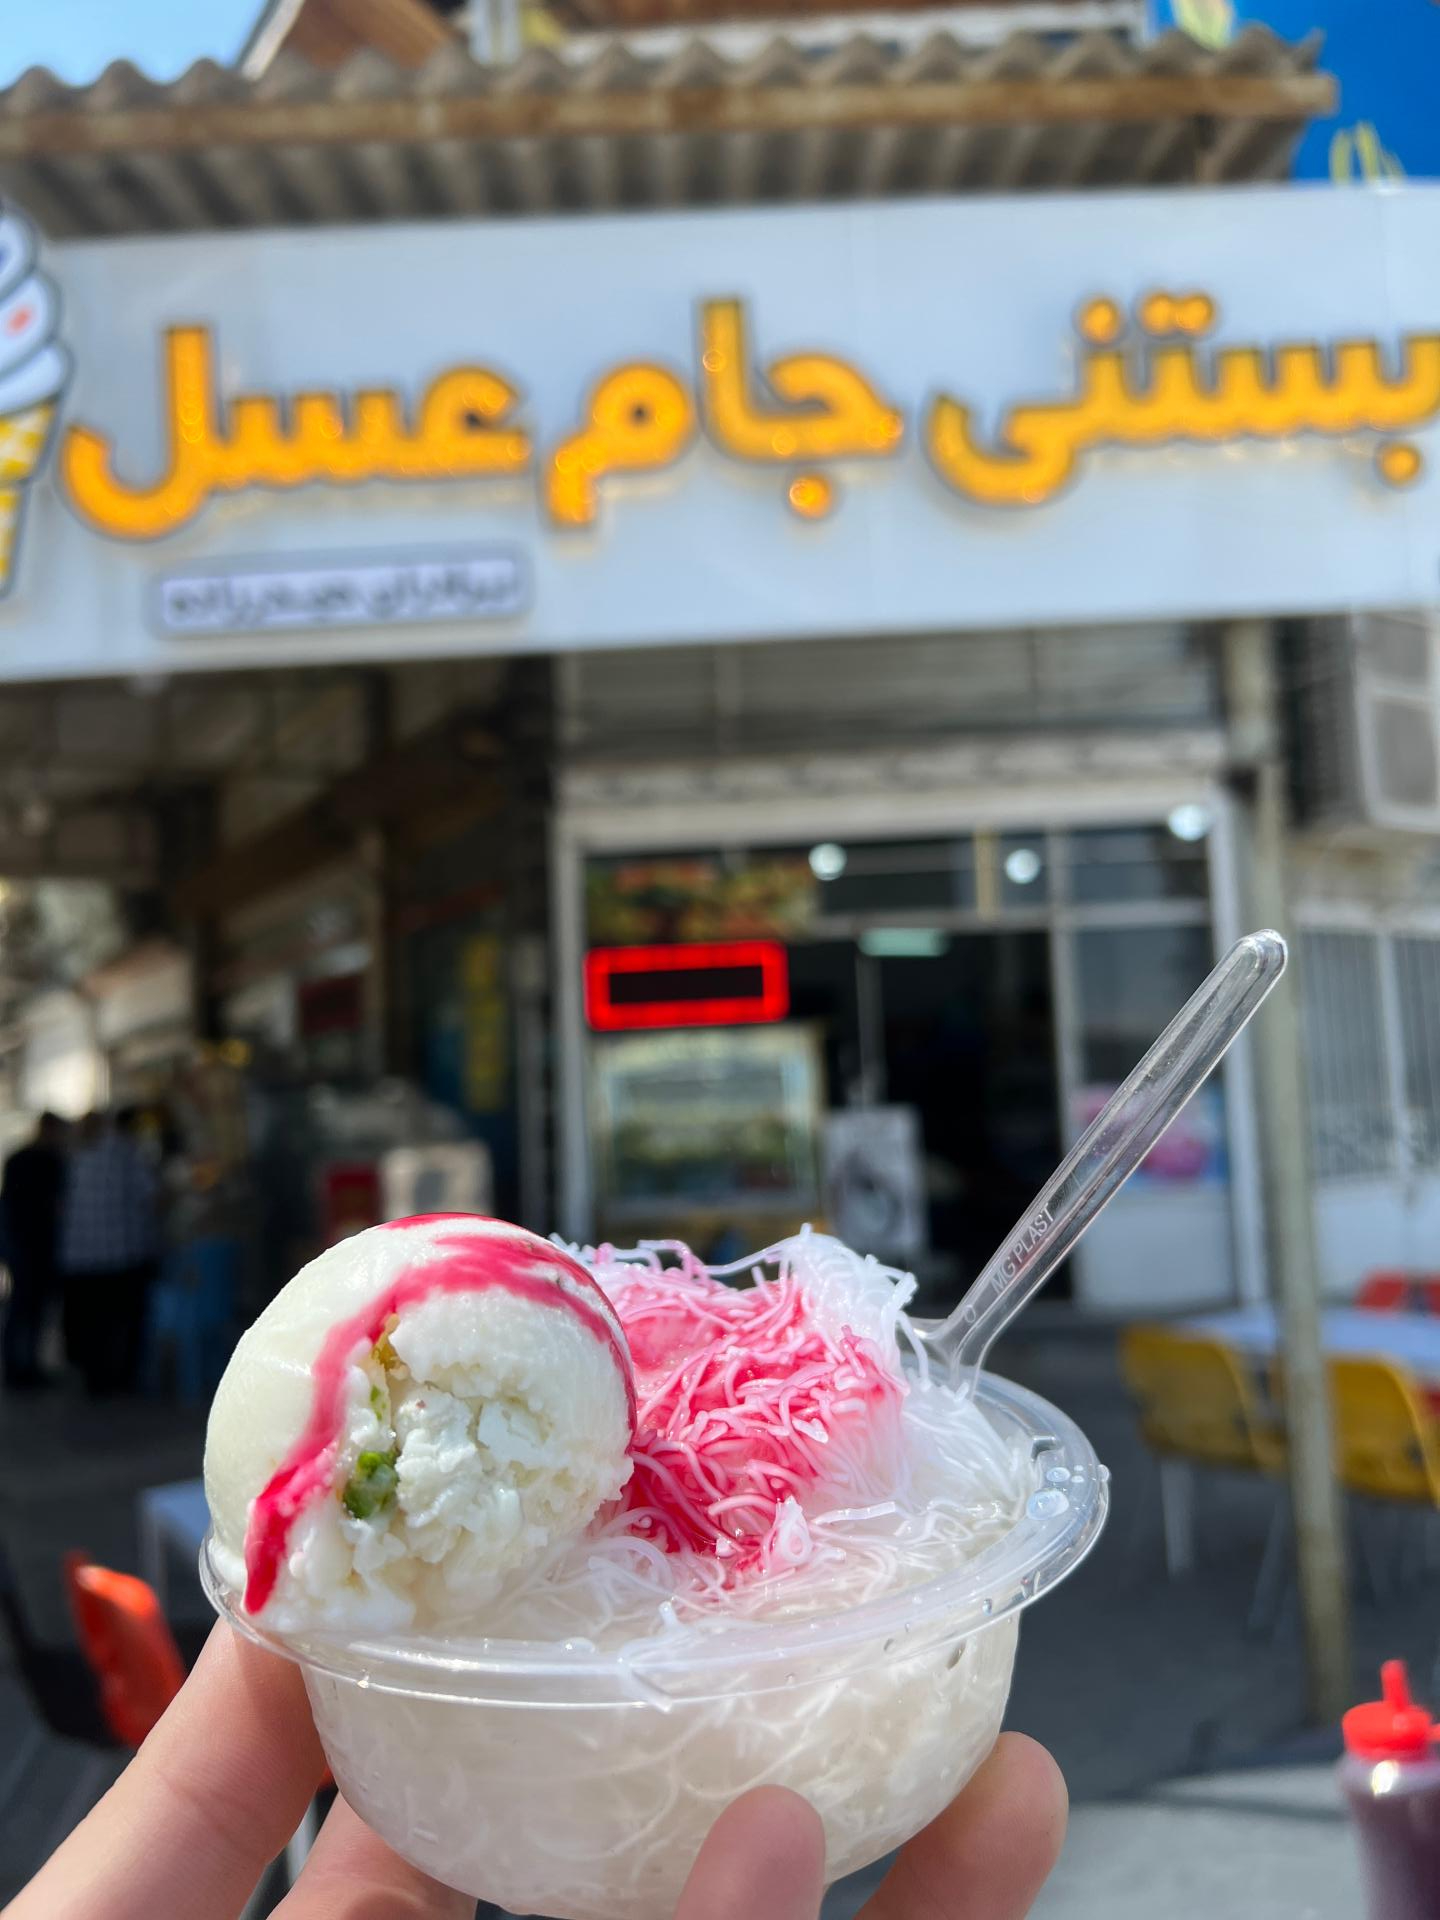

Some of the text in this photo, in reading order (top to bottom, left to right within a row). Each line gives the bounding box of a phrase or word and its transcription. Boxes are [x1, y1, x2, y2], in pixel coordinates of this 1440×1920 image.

[62, 292, 1440, 537] بستنی جام عسل
[990, 1202, 1054, 1294] MG PLAST
